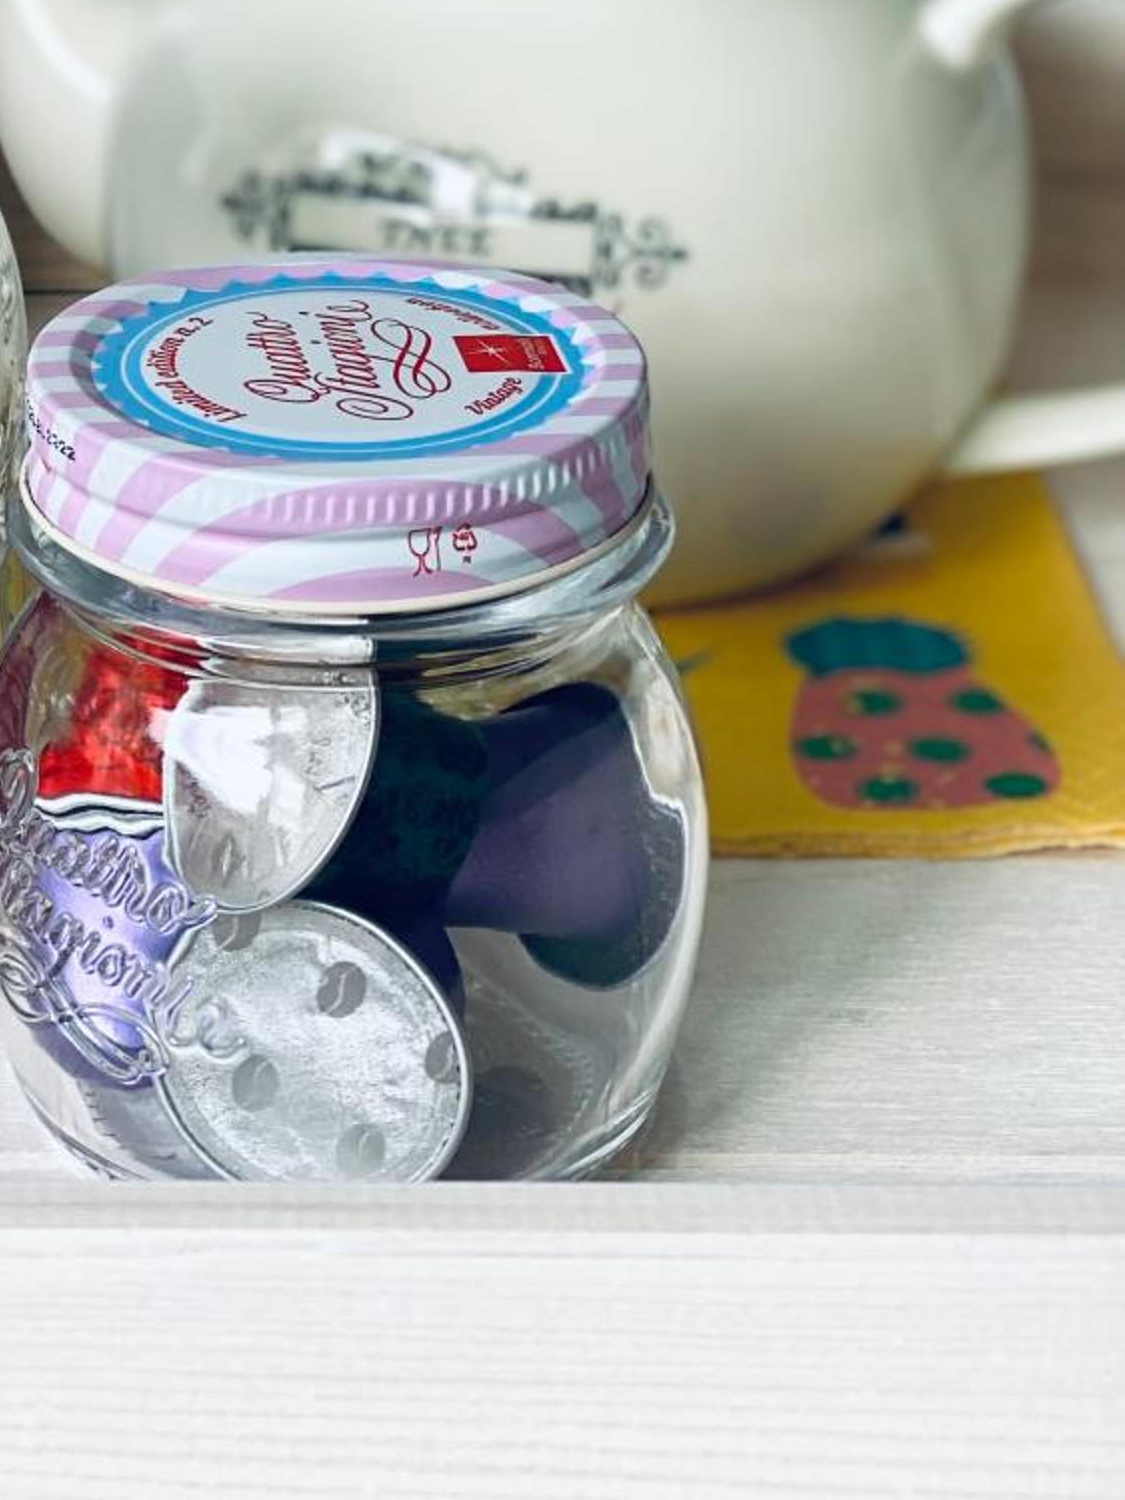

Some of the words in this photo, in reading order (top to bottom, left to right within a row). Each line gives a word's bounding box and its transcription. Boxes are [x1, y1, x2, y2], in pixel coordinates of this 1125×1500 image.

[146, 337, 185, 378] edition
[243, 310, 321, 404] Quattro
[154, 380, 247, 422] Limited
[463, 376, 522, 416] Vintage
